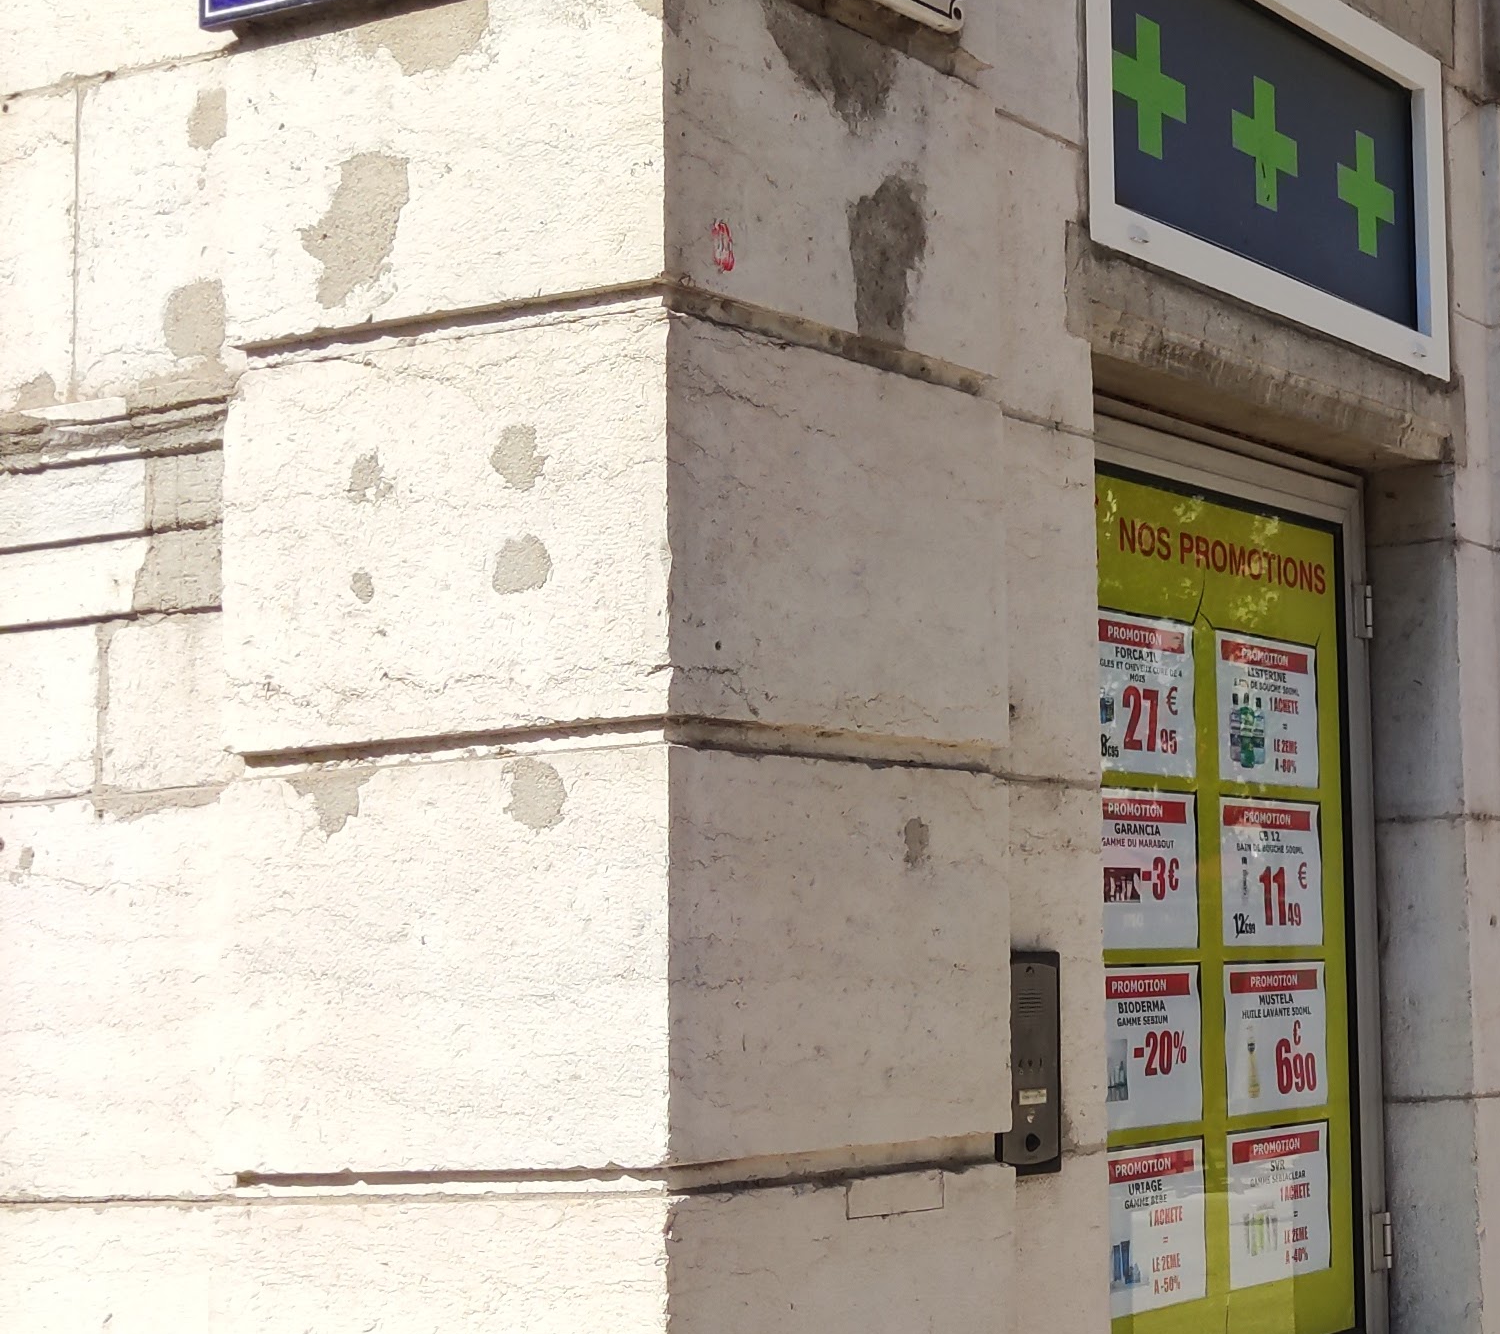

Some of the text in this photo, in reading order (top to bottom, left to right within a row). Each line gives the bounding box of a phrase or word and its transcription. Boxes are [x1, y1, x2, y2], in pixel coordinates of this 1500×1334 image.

[1119, 517, 1327, 595] NOS PROMOTIONS
[1108, 625, 1162, 646] PROMOTION
[1242, 648, 1288, 666] PROMOTION
[1248, 667, 1287, 683] LISTERINE
[1122, 685, 1159, 752] 27
[1108, 802, 1163, 817] PROMOTION
[1243, 811, 1291, 825] PROMOTION
[1115, 822, 1161, 836] GARANCIA
[1271, 831, 1280, 842] 12
[1128, 838, 1137, 848] DU
[1259, 866, 1286, 926] 11
[1111, 979, 1167, 994] PROMOTION
[1250, 974, 1298, 987] PROMOTION
[1118, 1000, 1166, 1014] BIODERMA
[1259, 993, 1294, 1006] MUSTELA
[1263, 1007, 1290, 1018] LAVANTE
[1117, 1017, 1141, 1027] GAMME
[1133, 1030, 1187, 1076] -20%
[1253, 1137, 1300, 1156] PROMOTION
[1115, 1158, 1171, 1177] PROMOTION
[1270, 1160, 1286, 1172] SVR
[1128, 1179, 1162, 1195] URIAGE
[1285, 1183, 1311, 1201] ACHETE
[1154, 1206, 1183, 1226] ACHETE
[1152, 1253, 1181, 1273] LE 2EME
[1153, 1275, 1181, 1295] A -50%
